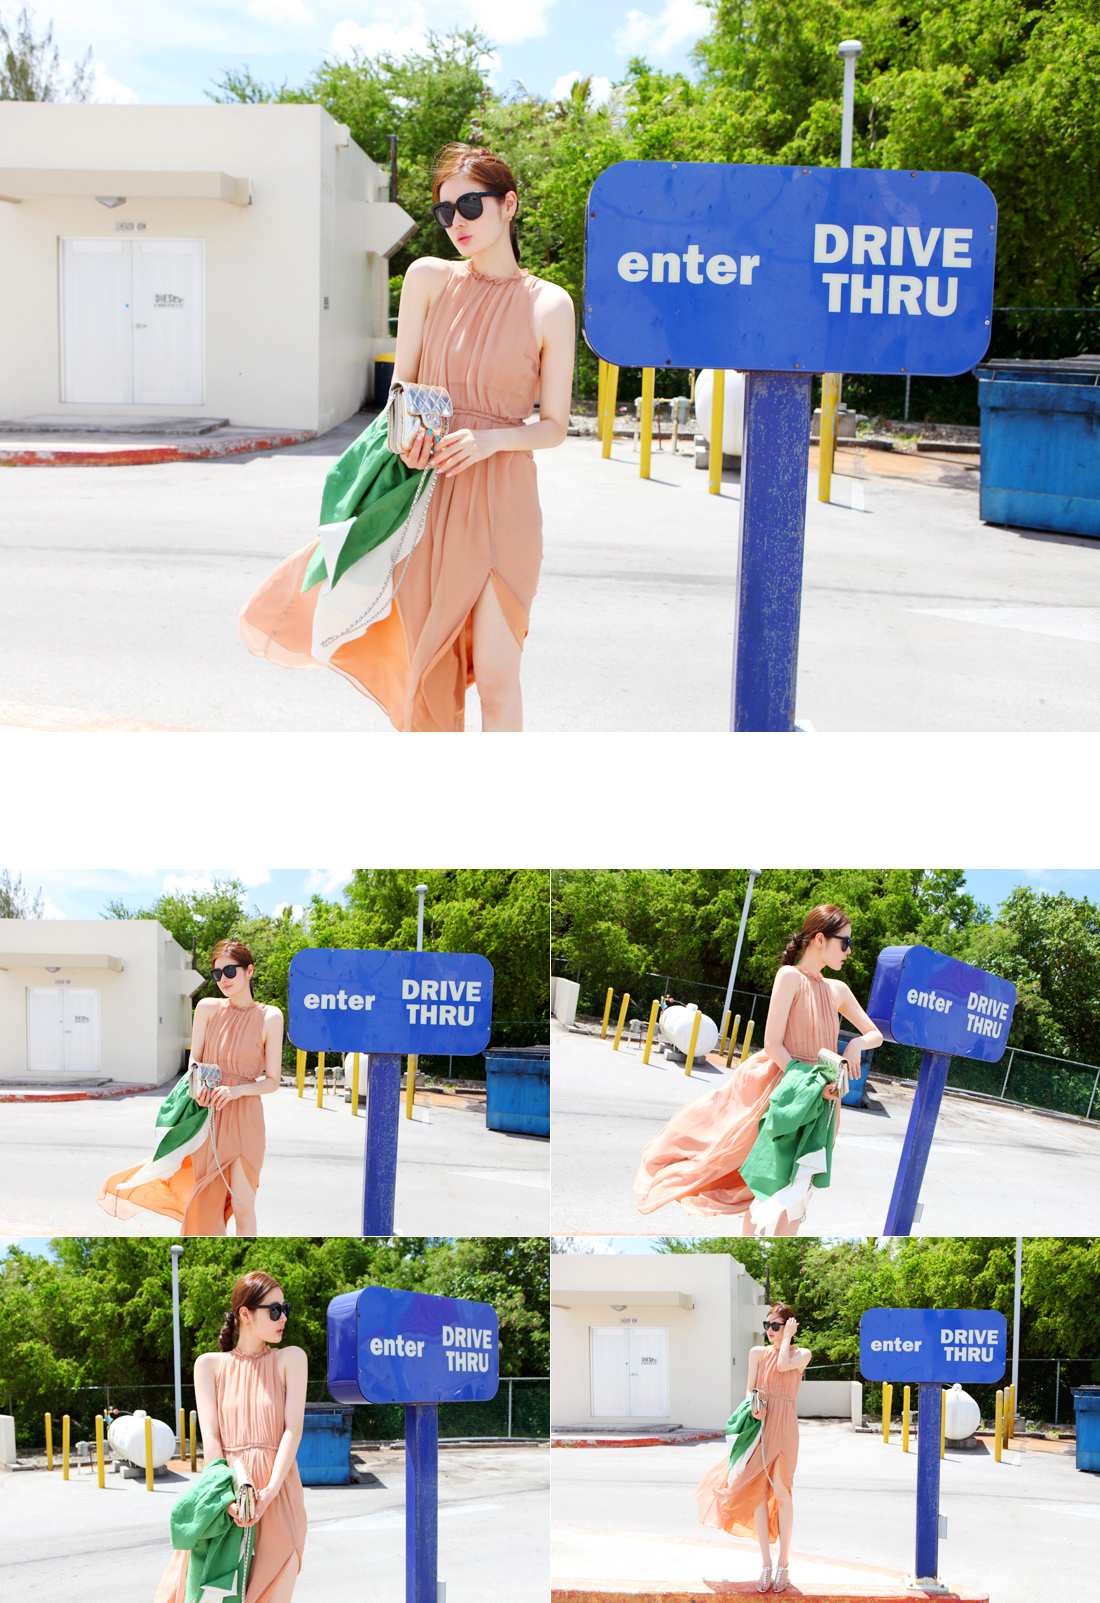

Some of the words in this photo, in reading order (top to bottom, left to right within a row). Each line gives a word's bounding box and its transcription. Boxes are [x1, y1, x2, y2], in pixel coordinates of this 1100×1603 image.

[813, 223, 973, 267] DRIVE
[617, 244, 761, 285] enter
[822, 272, 959, 317] THRU
[304, 990, 376, 1011] enter
[402, 980, 482, 1002] DRIVE
[907, 989, 953, 1014] enter
[407, 1004, 475, 1026] THRU
[967, 992, 1009, 1020] DRIVE
[967, 1014, 1003, 1038] THRU
[370, 1335, 424, 1357] enter
[442, 1326, 492, 1349] DRIVE
[871, 1338, 922, 1352] enter
[941, 1330, 998, 1344] DRIVE
[446, 1351, 489, 1372] THRU
[944, 1347, 993, 1362] THRU
